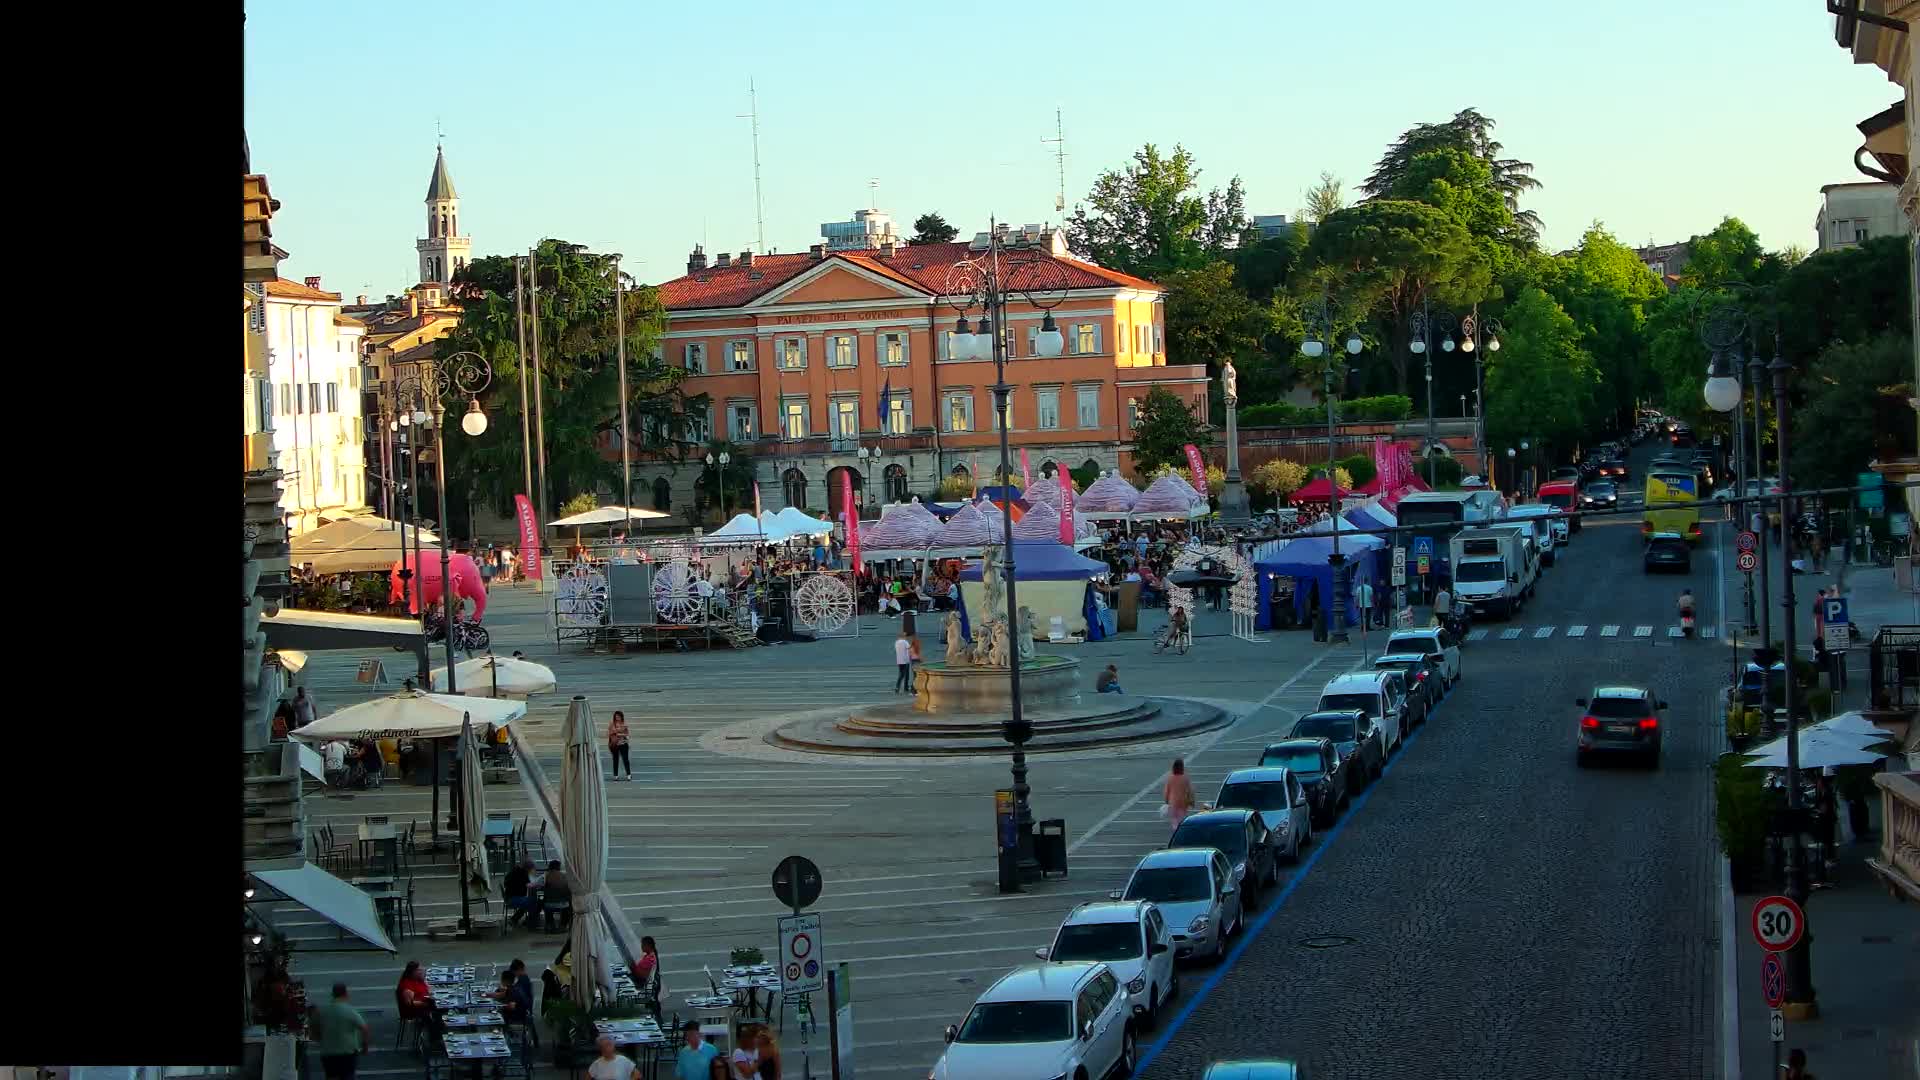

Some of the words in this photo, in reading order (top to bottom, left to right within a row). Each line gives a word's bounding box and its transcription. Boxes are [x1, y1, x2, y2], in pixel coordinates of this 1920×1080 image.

[1742, 556, 1753, 566] 20
[1827, 601, 1842, 621] P
[357, 727, 421, 740] Piadineria
[1761, 910, 1792, 937] 30
